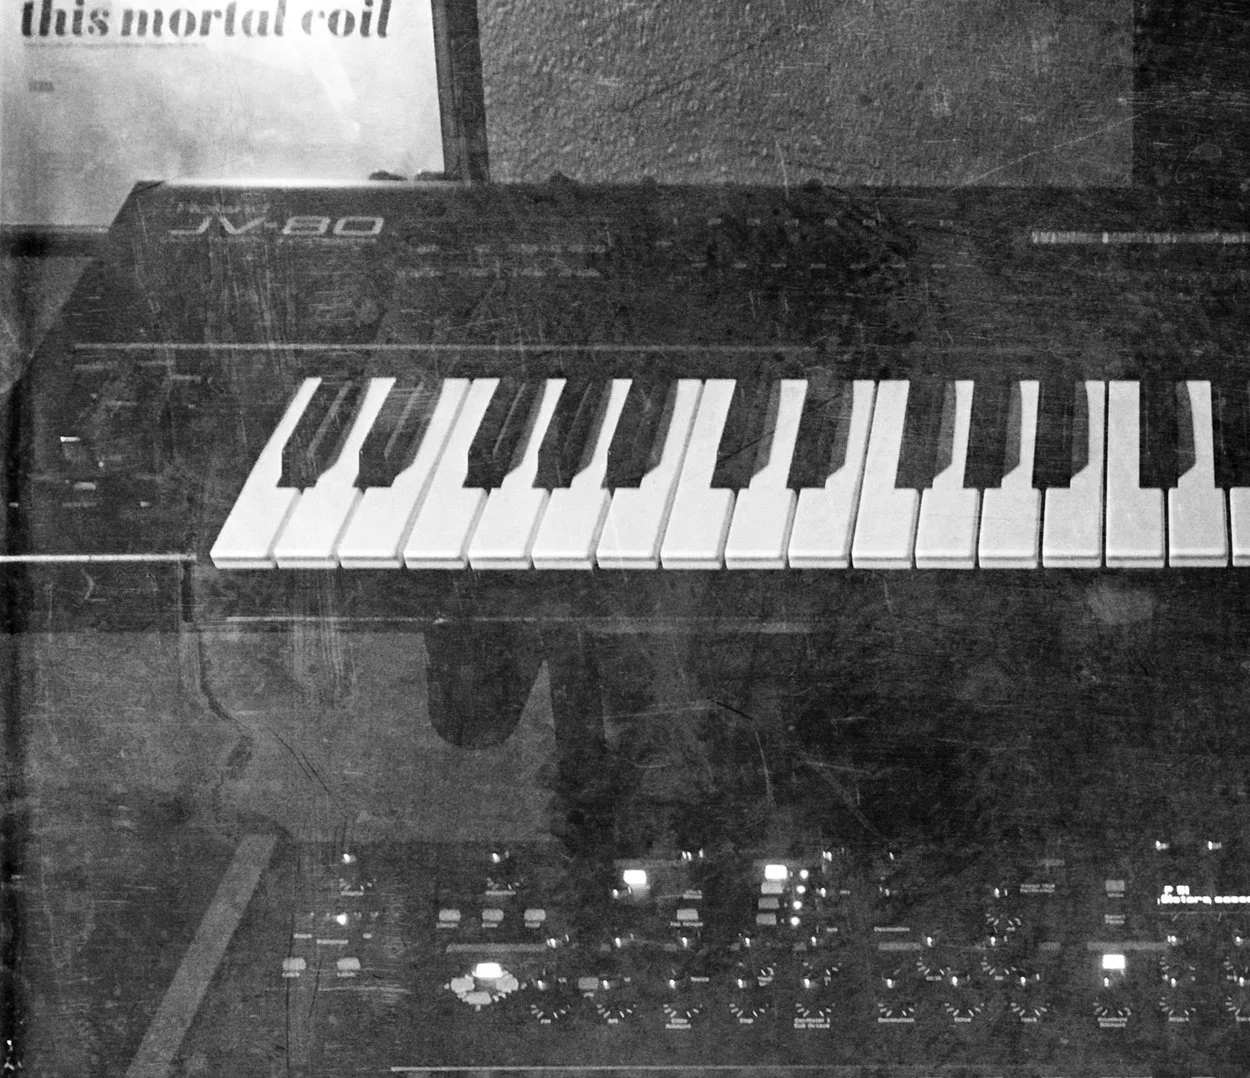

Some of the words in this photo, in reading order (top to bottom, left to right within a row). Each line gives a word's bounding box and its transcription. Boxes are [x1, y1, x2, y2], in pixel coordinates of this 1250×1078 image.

[20, 0, 109, 38] this
[119, 0, 286, 38] mortal
[301, 0, 392, 38] coil
